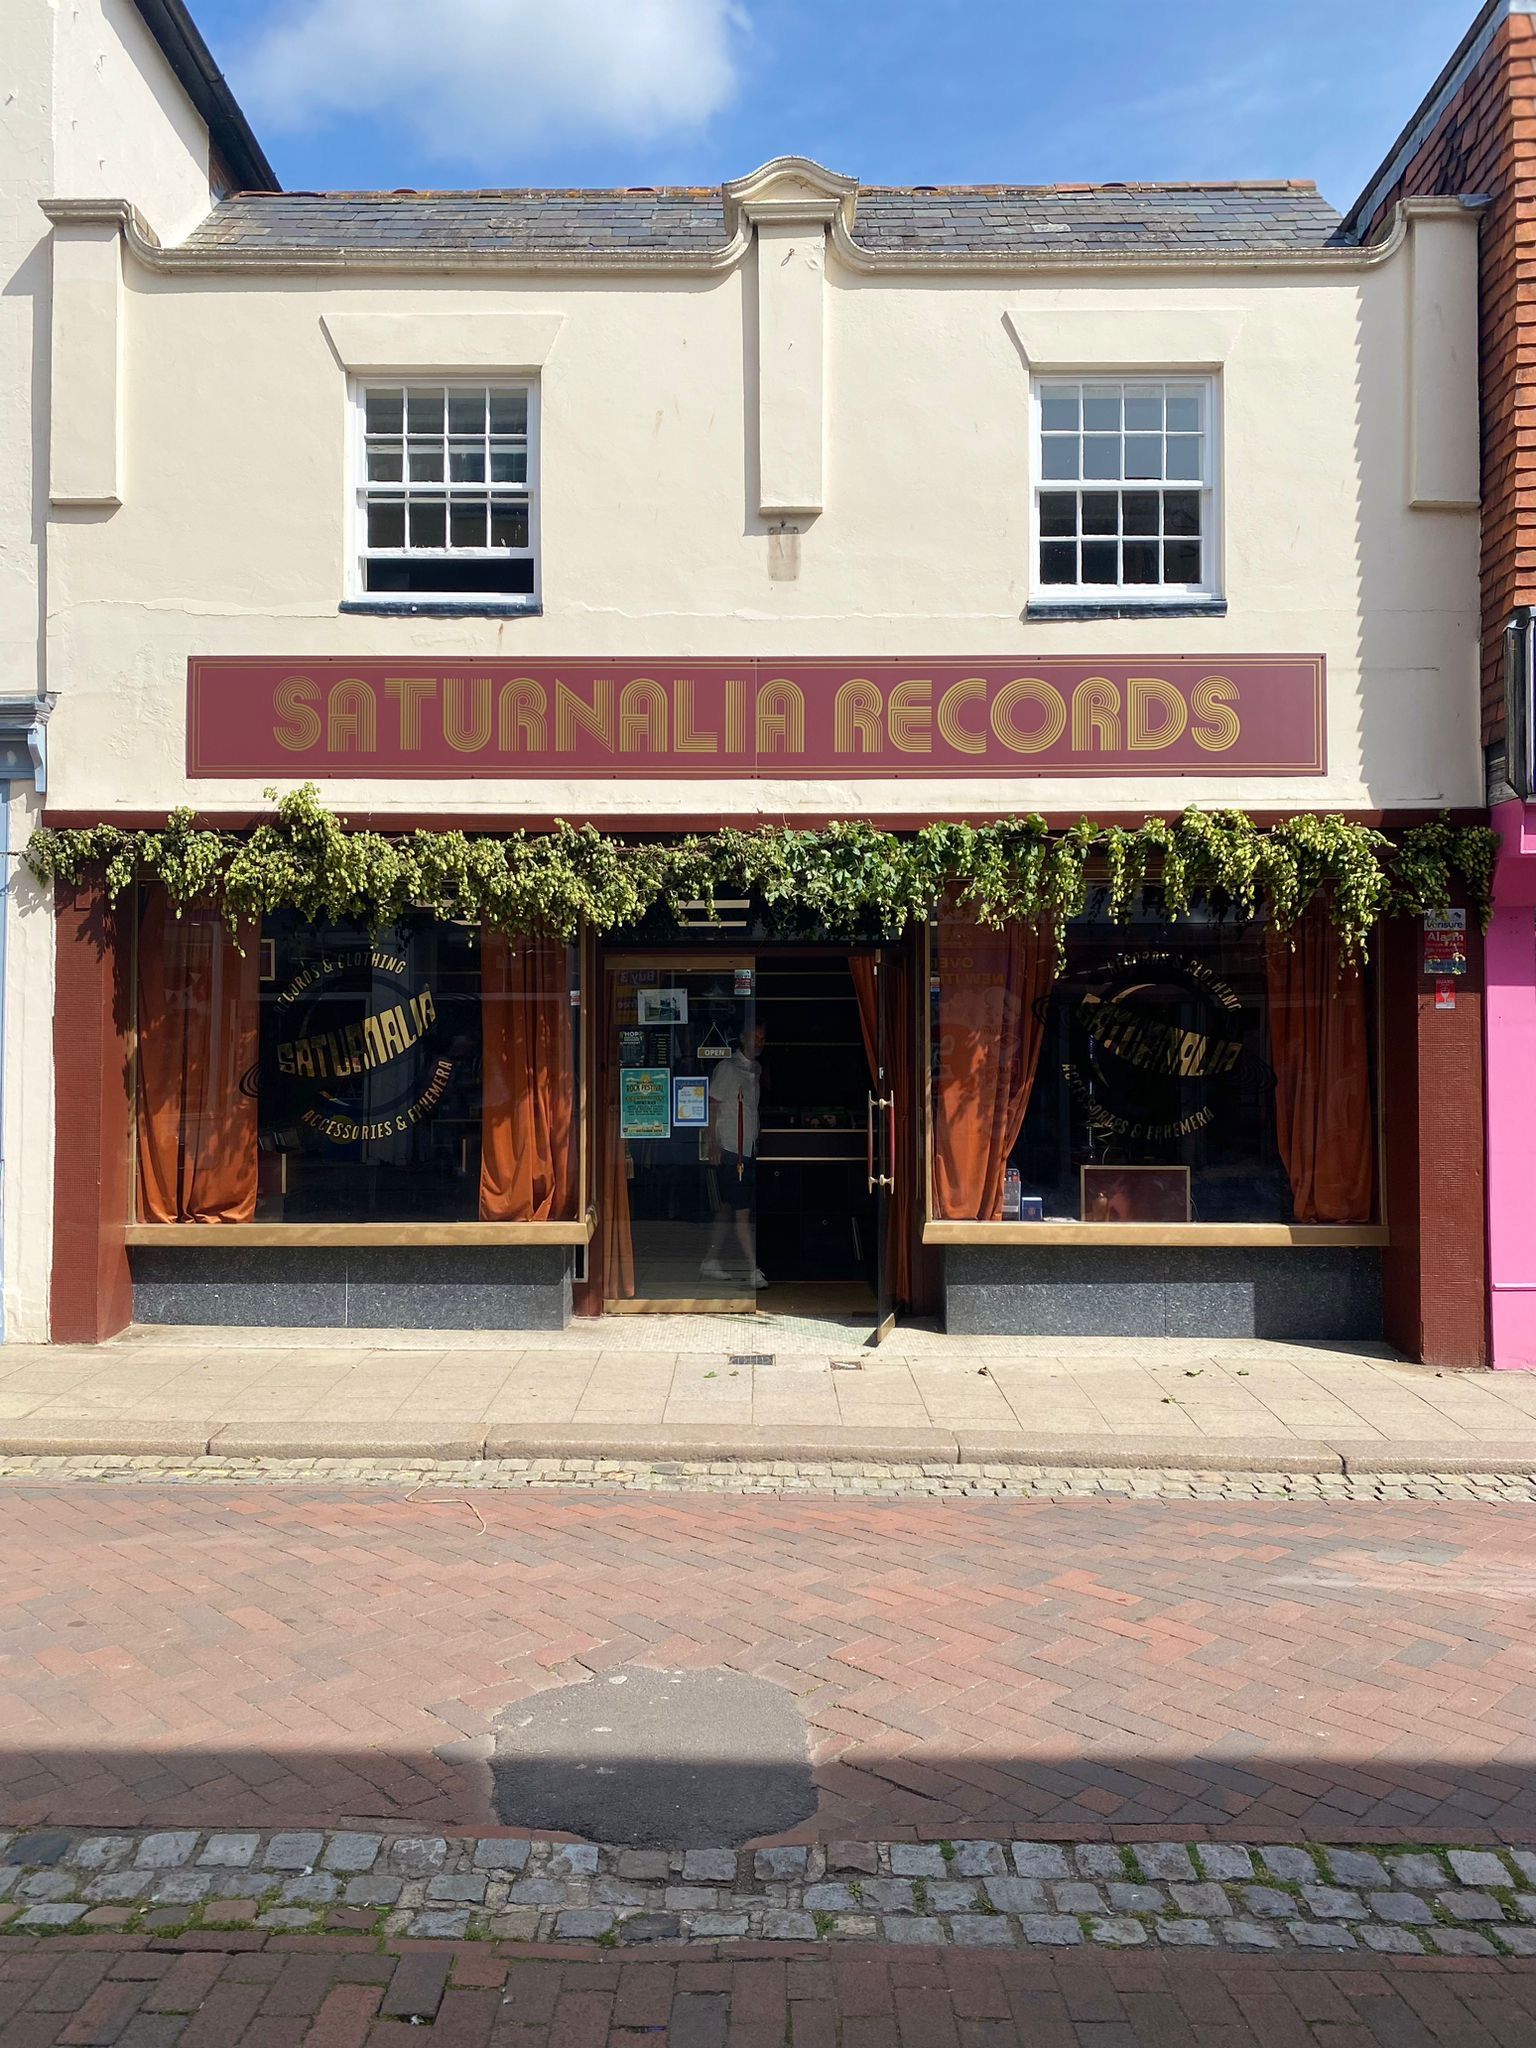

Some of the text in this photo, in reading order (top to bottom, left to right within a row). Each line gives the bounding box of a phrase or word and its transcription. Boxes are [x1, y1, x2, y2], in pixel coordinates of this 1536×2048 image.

[272, 674, 1242, 754] SATURNALIA RECORDS
[1427, 931, 1464, 942] Alam
[273, 951, 407, 1017] RECORDS & CLOTHING
[277, 990, 438, 1079] SATURNALIA
[300, 1058, 453, 1141] ACCESSORIES & EPHEMERA
[626, 1083, 664, 1092] ROCK FESTIVAL
[1145, 1105, 1216, 1143] EPHEMERA
